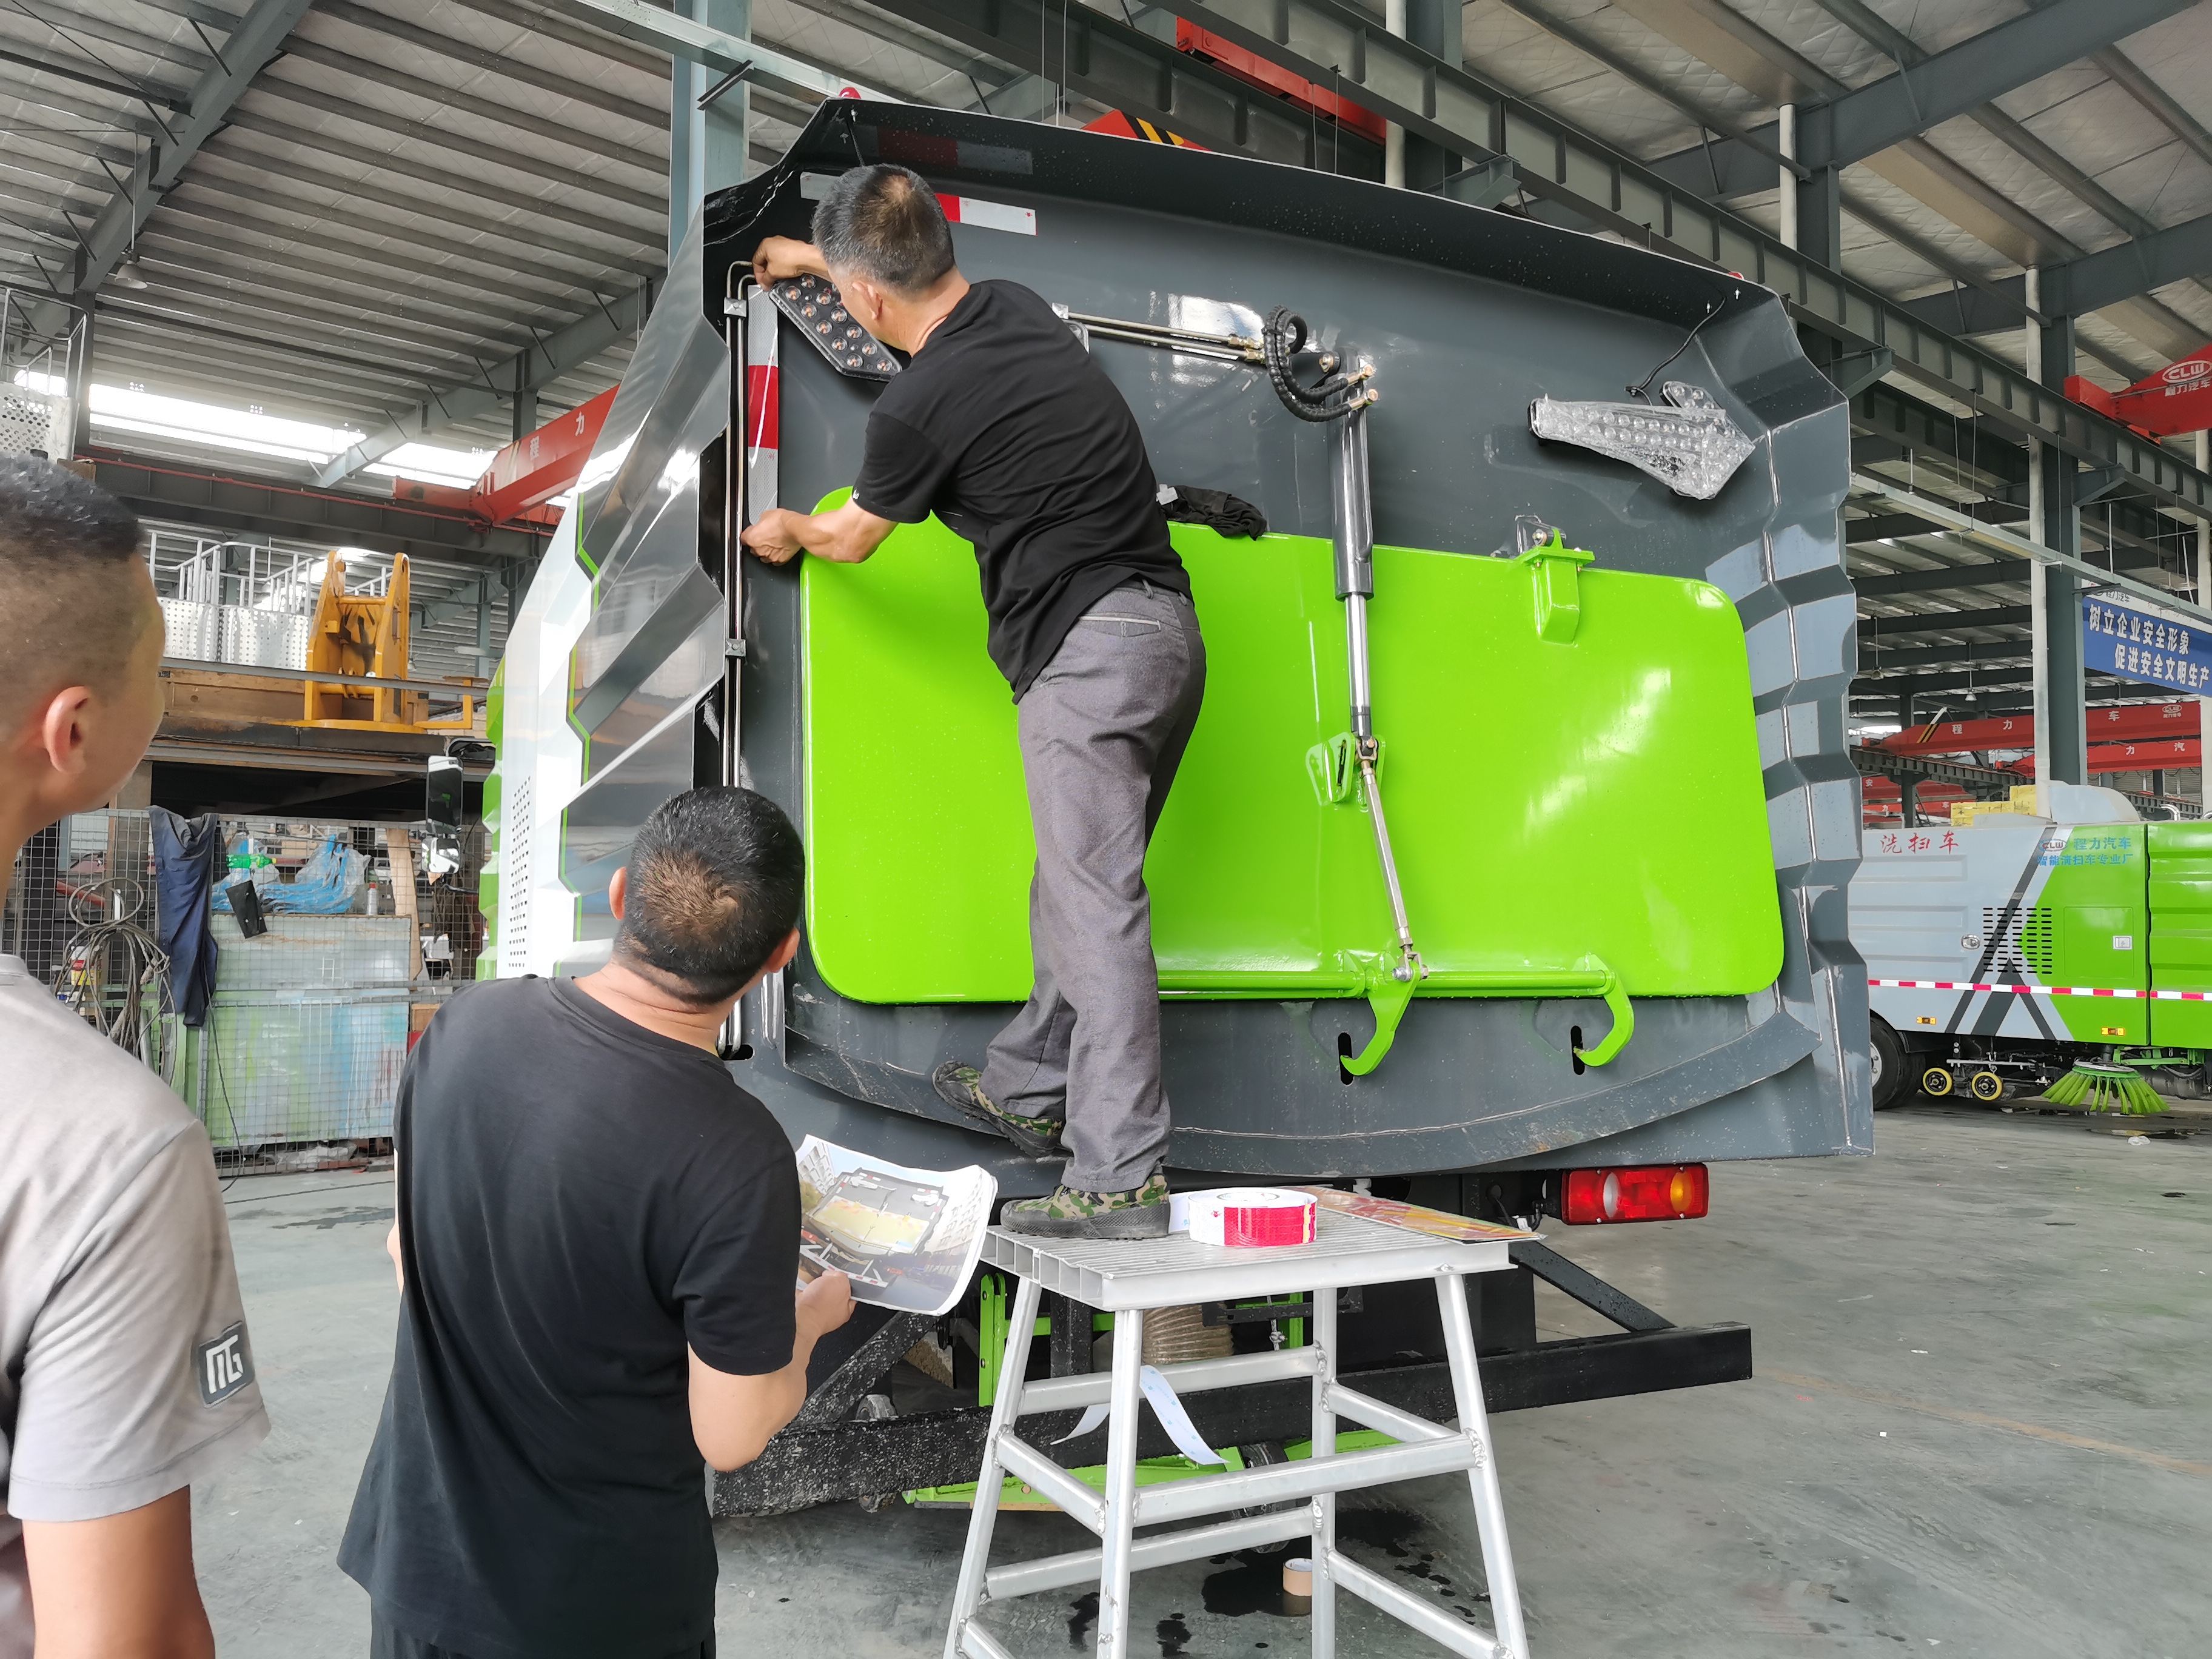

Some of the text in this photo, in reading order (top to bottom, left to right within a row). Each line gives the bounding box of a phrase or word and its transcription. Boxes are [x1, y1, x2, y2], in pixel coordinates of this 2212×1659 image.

[2168, 363, 2204, 380] CLW
[2089, 603, 2190, 655] 树立企业安全形象
[2114, 642, 2210, 689] 促进安全文明生产
[1880, 830, 1959, 855] 洗扫车
[2073, 837, 2132, 850] 程力汽车
